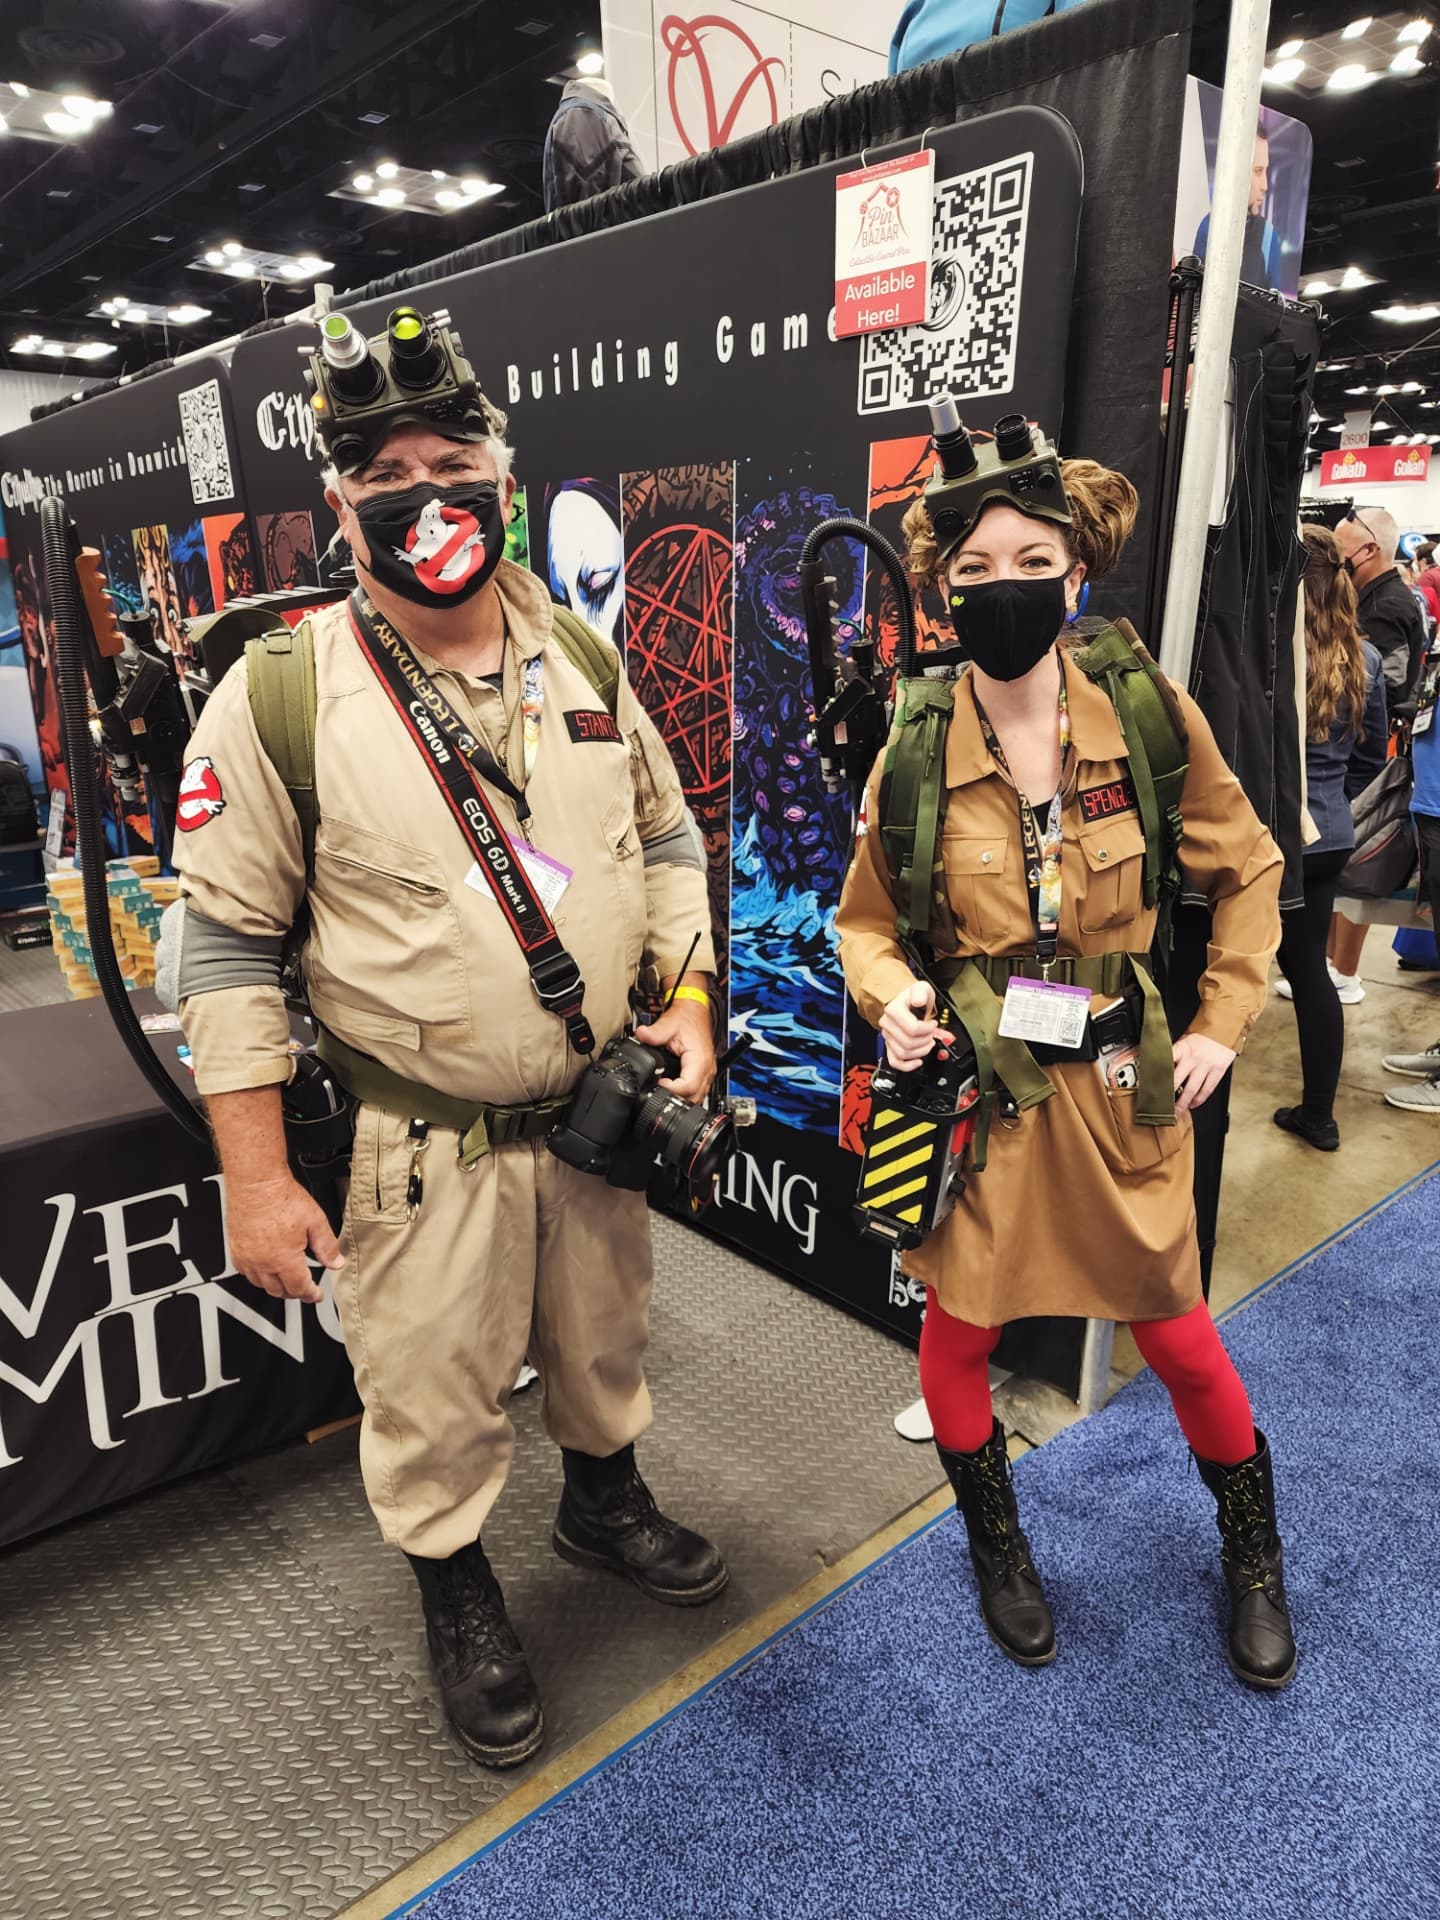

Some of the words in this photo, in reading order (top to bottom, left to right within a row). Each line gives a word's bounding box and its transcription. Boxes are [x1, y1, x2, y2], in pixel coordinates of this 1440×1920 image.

[862, 223, 899, 248] BAZAAR
[868, 206, 893, 228] Pin
[844, 270, 916, 303] Available
[857, 303, 900, 329] Here!
[506, 338, 679, 404] Building
[256, 391, 314, 461] Cth
[66, 467, 104, 493] Horror
[108, 457, 123, 482] in
[127, 436, 187, 477] Dunwich
[1331, 460, 1367, 481] Goliath
[372, 621, 461, 734] LEGENDARY
[408, 700, 452, 765] Canon
[463, 798, 497, 845] EOS
[487, 846, 510, 872] 6D
[500, 874, 523, 906] Mark
